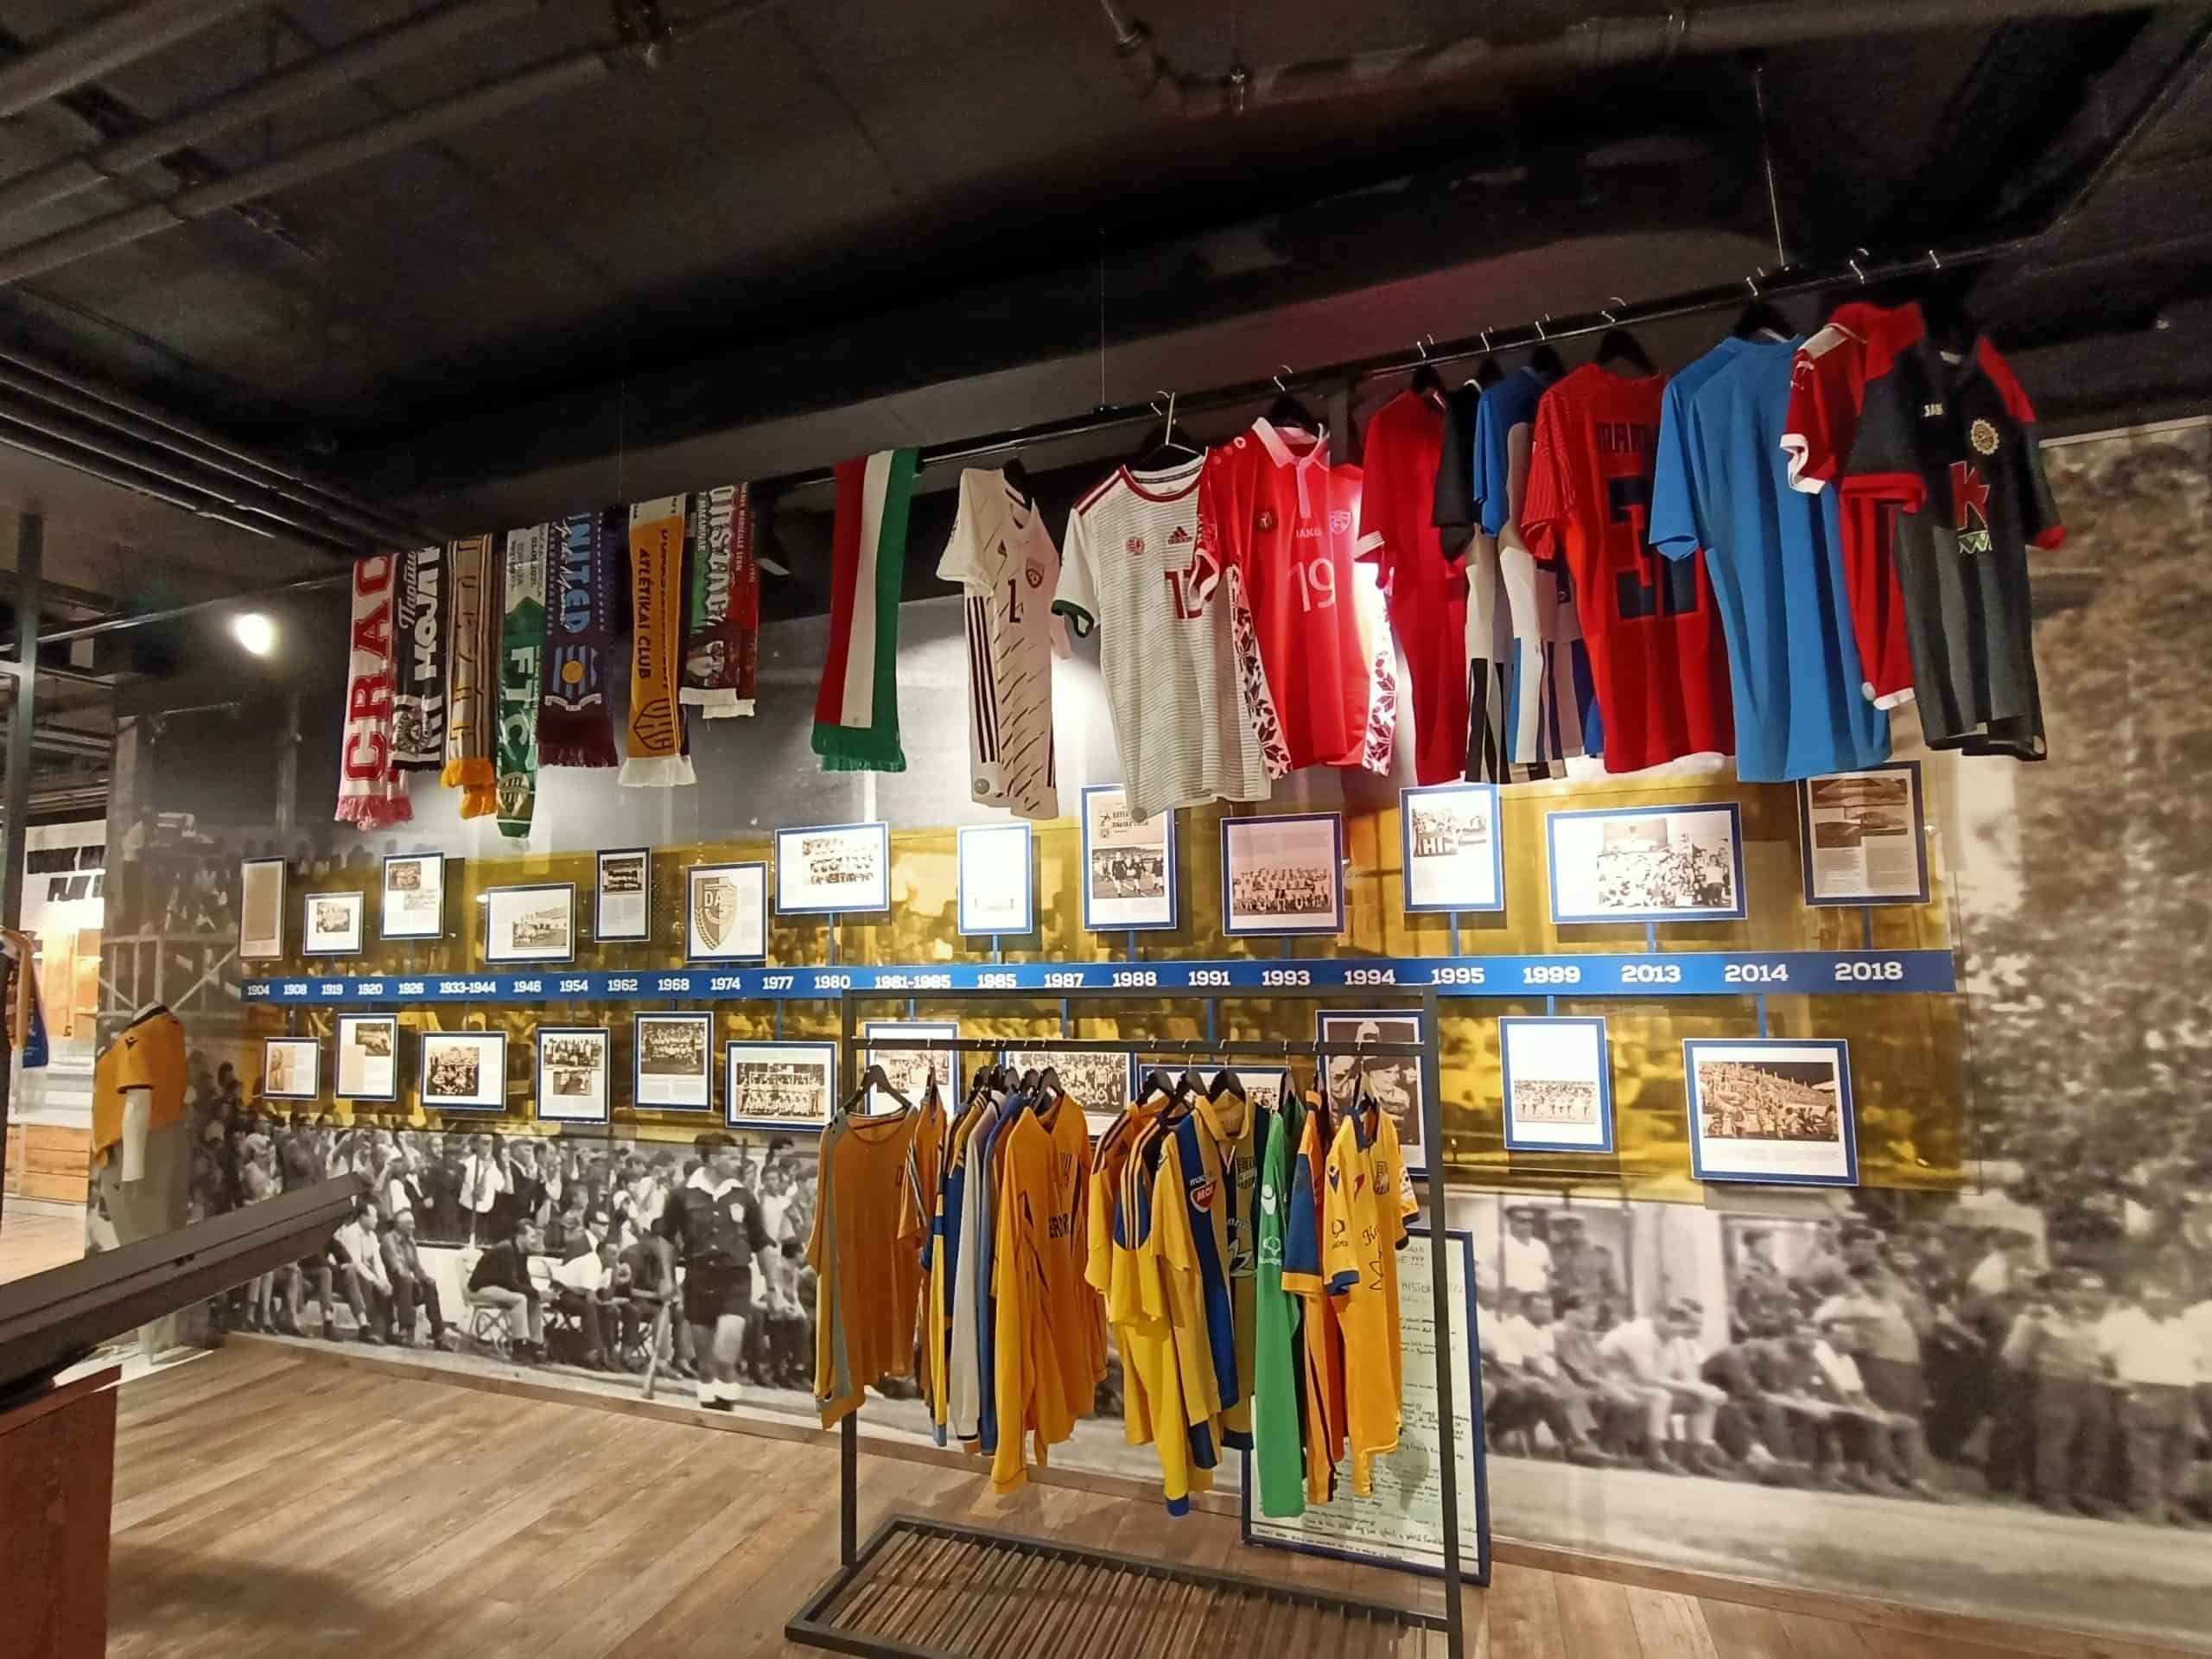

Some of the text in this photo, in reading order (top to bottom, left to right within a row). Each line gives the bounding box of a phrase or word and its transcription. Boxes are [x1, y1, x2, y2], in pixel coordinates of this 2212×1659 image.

[1287, 558, 1337, 612] 19
[638, 635, 652, 680] CLUB
[247, 962, 1904, 995] 1904 1908 1919 1920 1926 1933-1944 1946 1954 1962 1968 1974 1977 1980 1981-1985 1985 1987 1988 1991 1993 1994 1995 1999 2013 2014 2018
